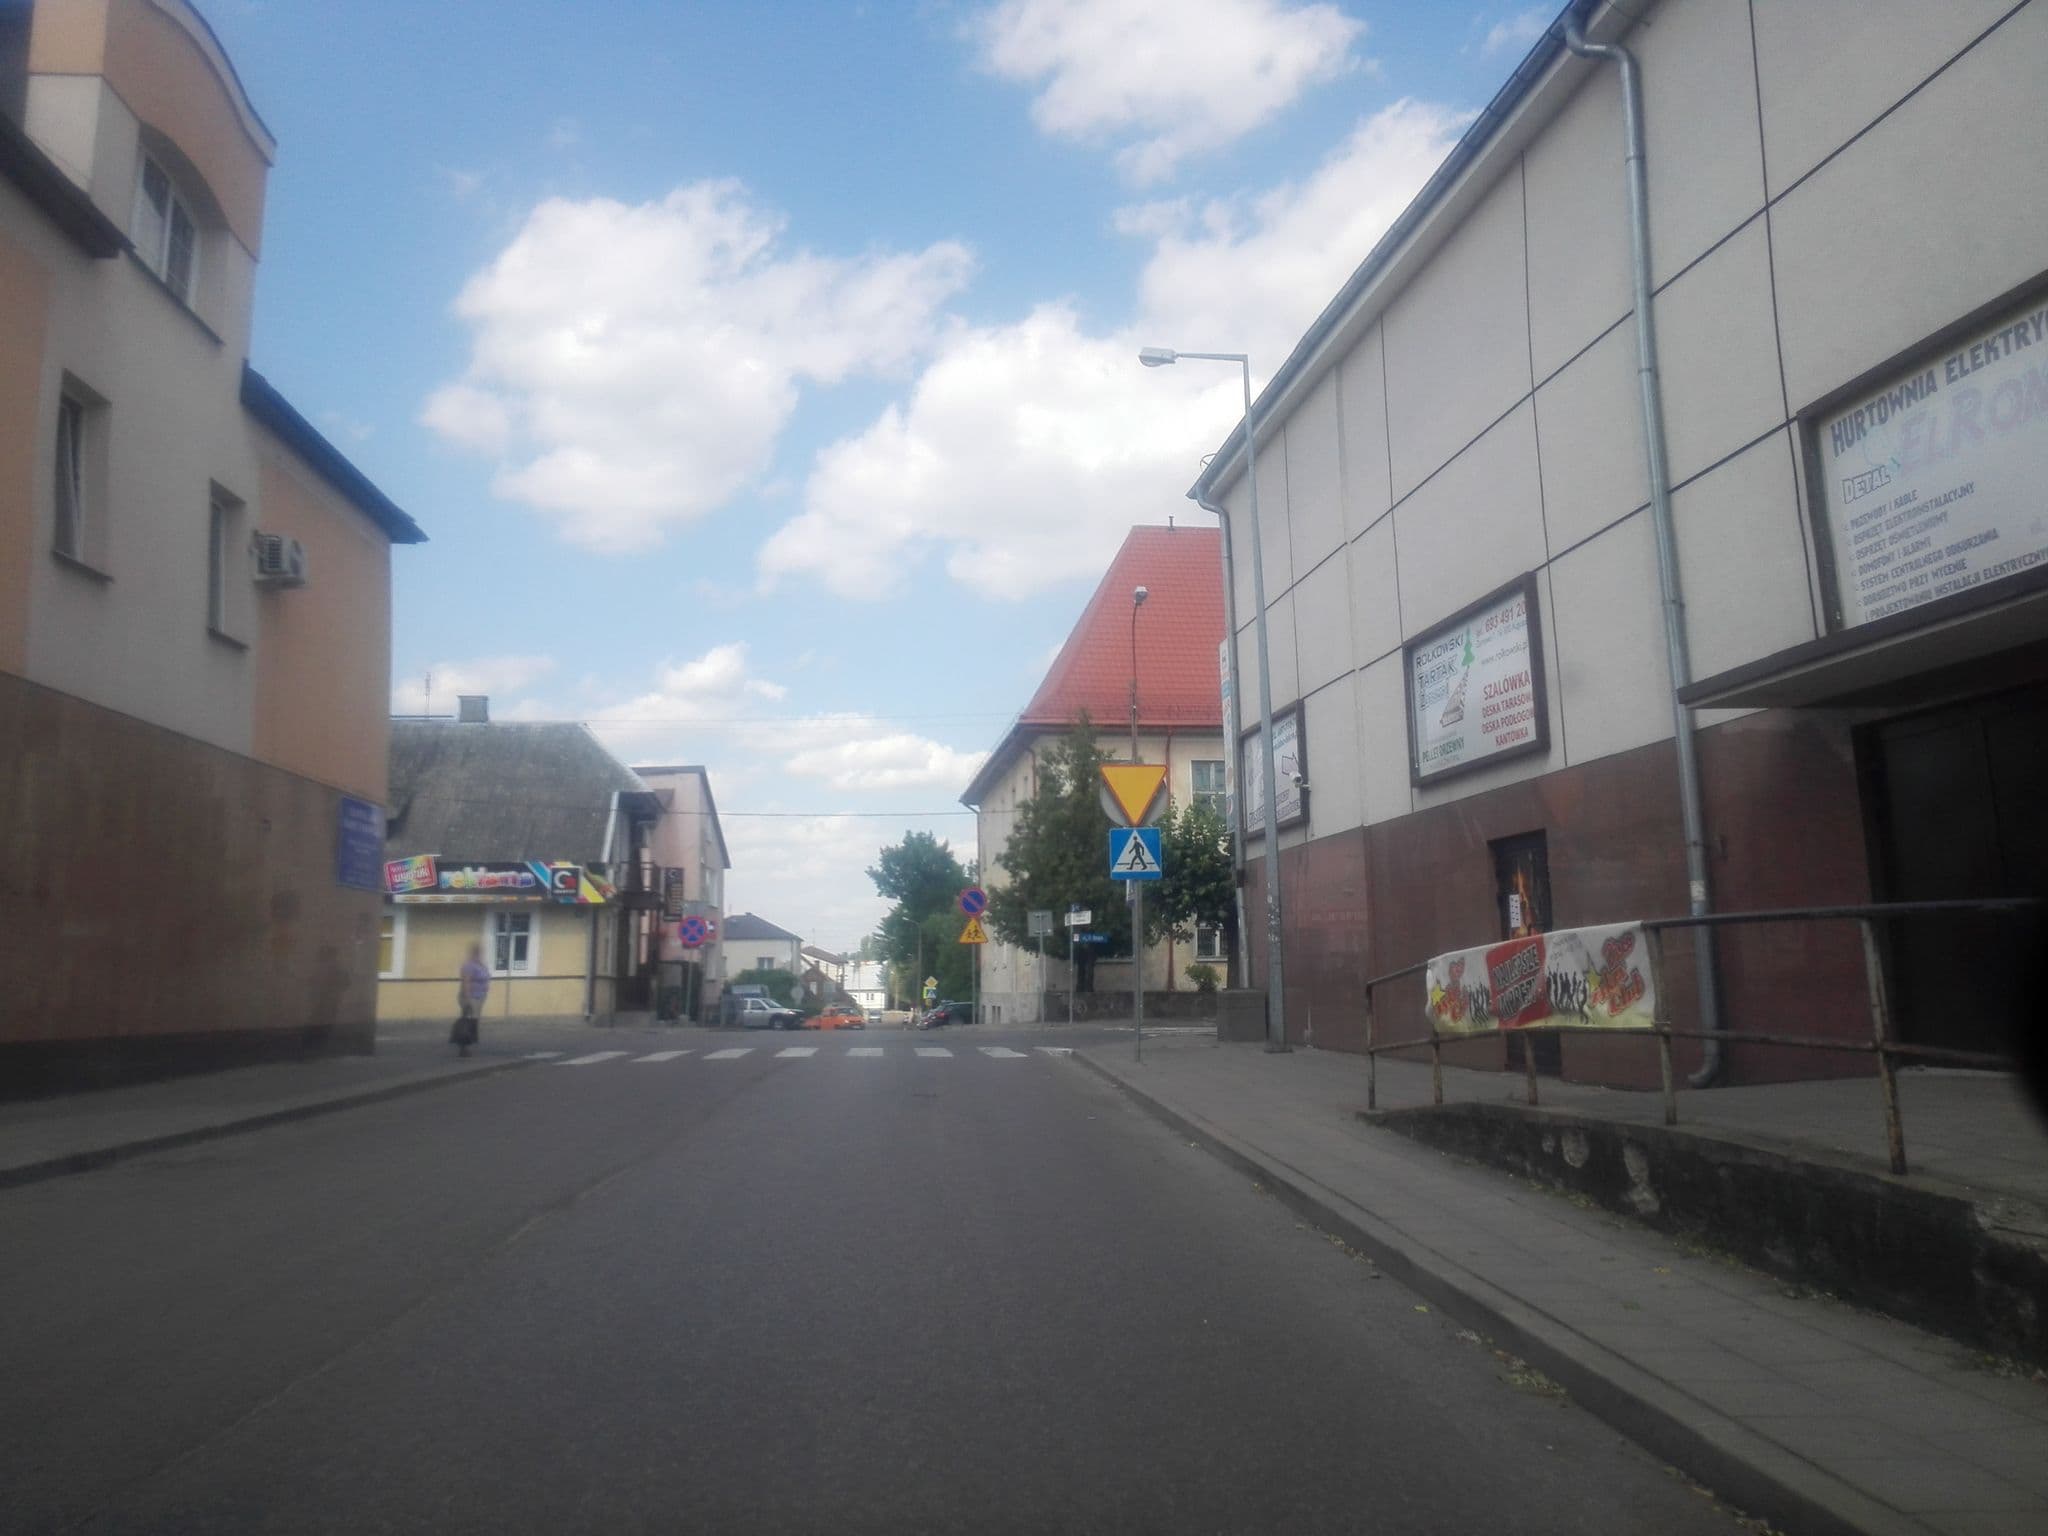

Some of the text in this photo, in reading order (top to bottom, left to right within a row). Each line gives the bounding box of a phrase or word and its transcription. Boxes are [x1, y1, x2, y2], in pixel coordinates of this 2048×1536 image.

[1829, 369, 1938, 459] HURTOWNIA
[1842, 465, 1891, 504] DETAL
[1416, 633, 1464, 669] ROŁKOWSKI
[1417, 653, 1459, 687] TARTAK
[1483, 670, 1531, 701] SZALÓWKA
